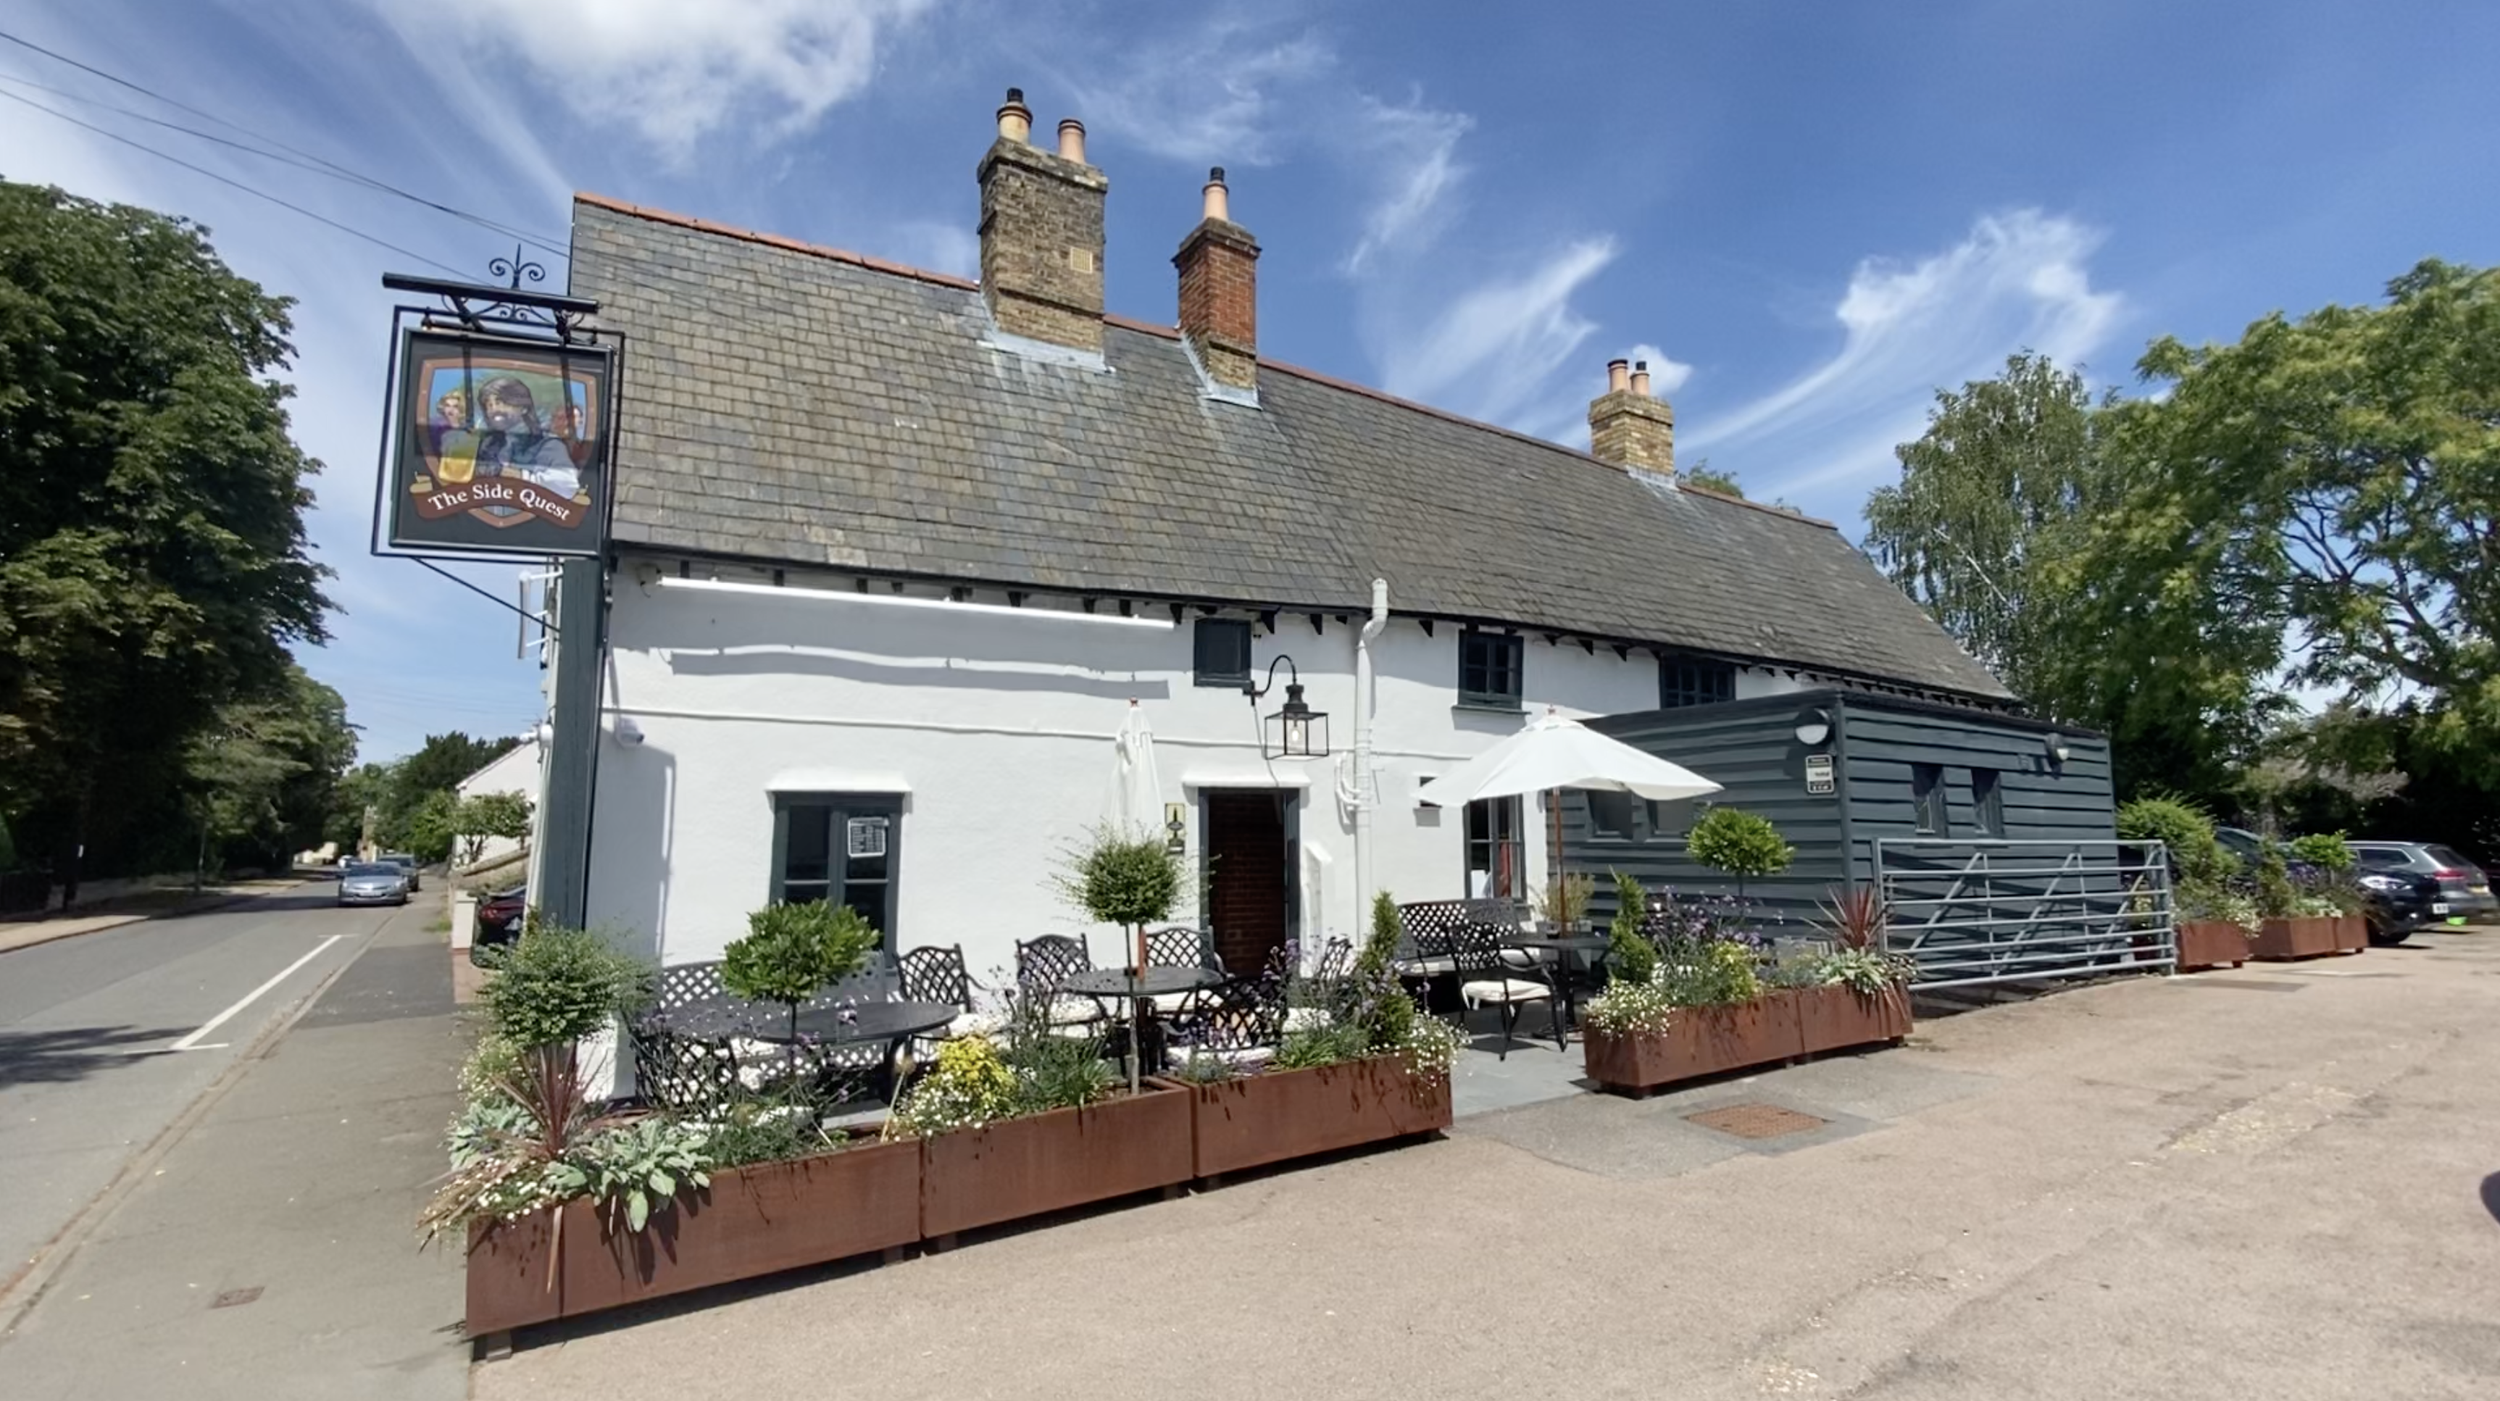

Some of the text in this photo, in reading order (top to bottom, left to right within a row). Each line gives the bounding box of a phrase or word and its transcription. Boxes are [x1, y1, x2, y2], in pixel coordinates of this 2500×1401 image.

[428, 483, 571, 521] The Side Quest
